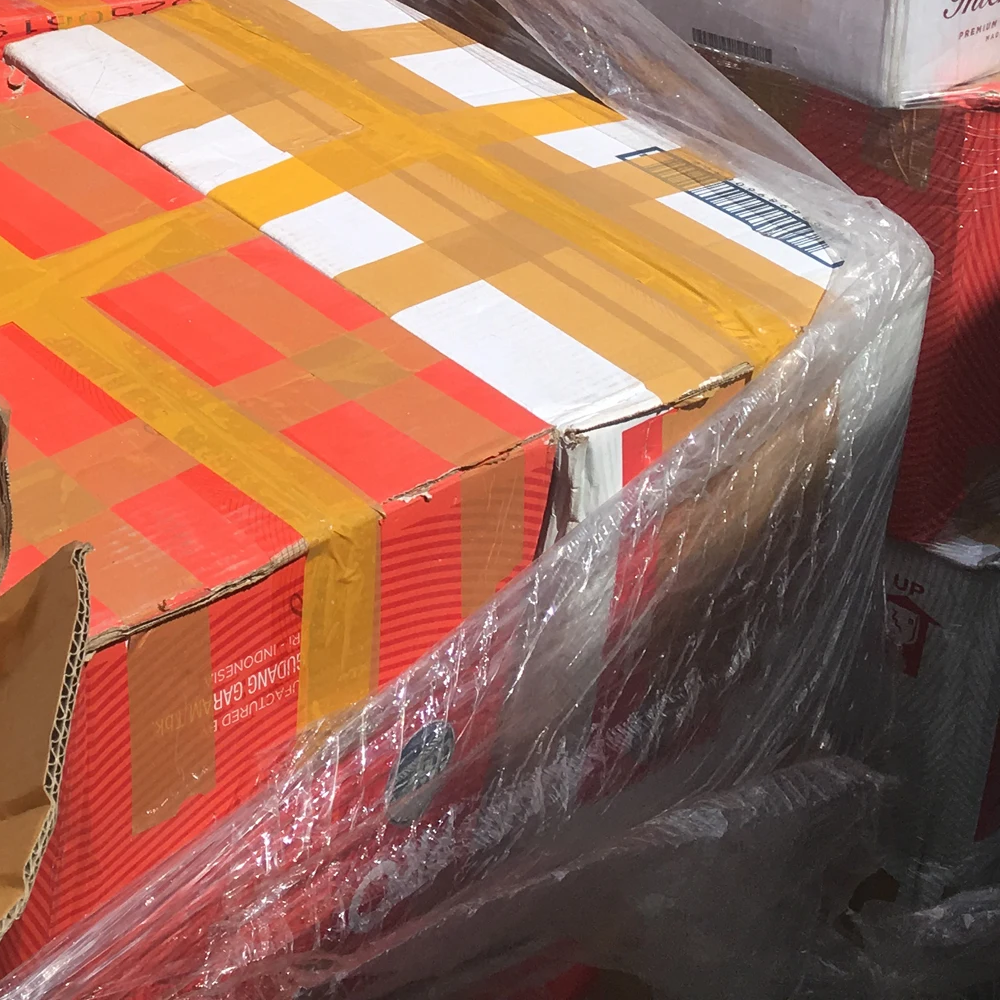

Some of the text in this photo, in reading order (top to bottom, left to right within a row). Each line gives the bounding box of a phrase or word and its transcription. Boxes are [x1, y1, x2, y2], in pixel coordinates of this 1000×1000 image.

[958, 20, 998, 40] PREMIUM
[893, 573, 925, 596] UP
[222, 679, 300, 727] UFACTURED
